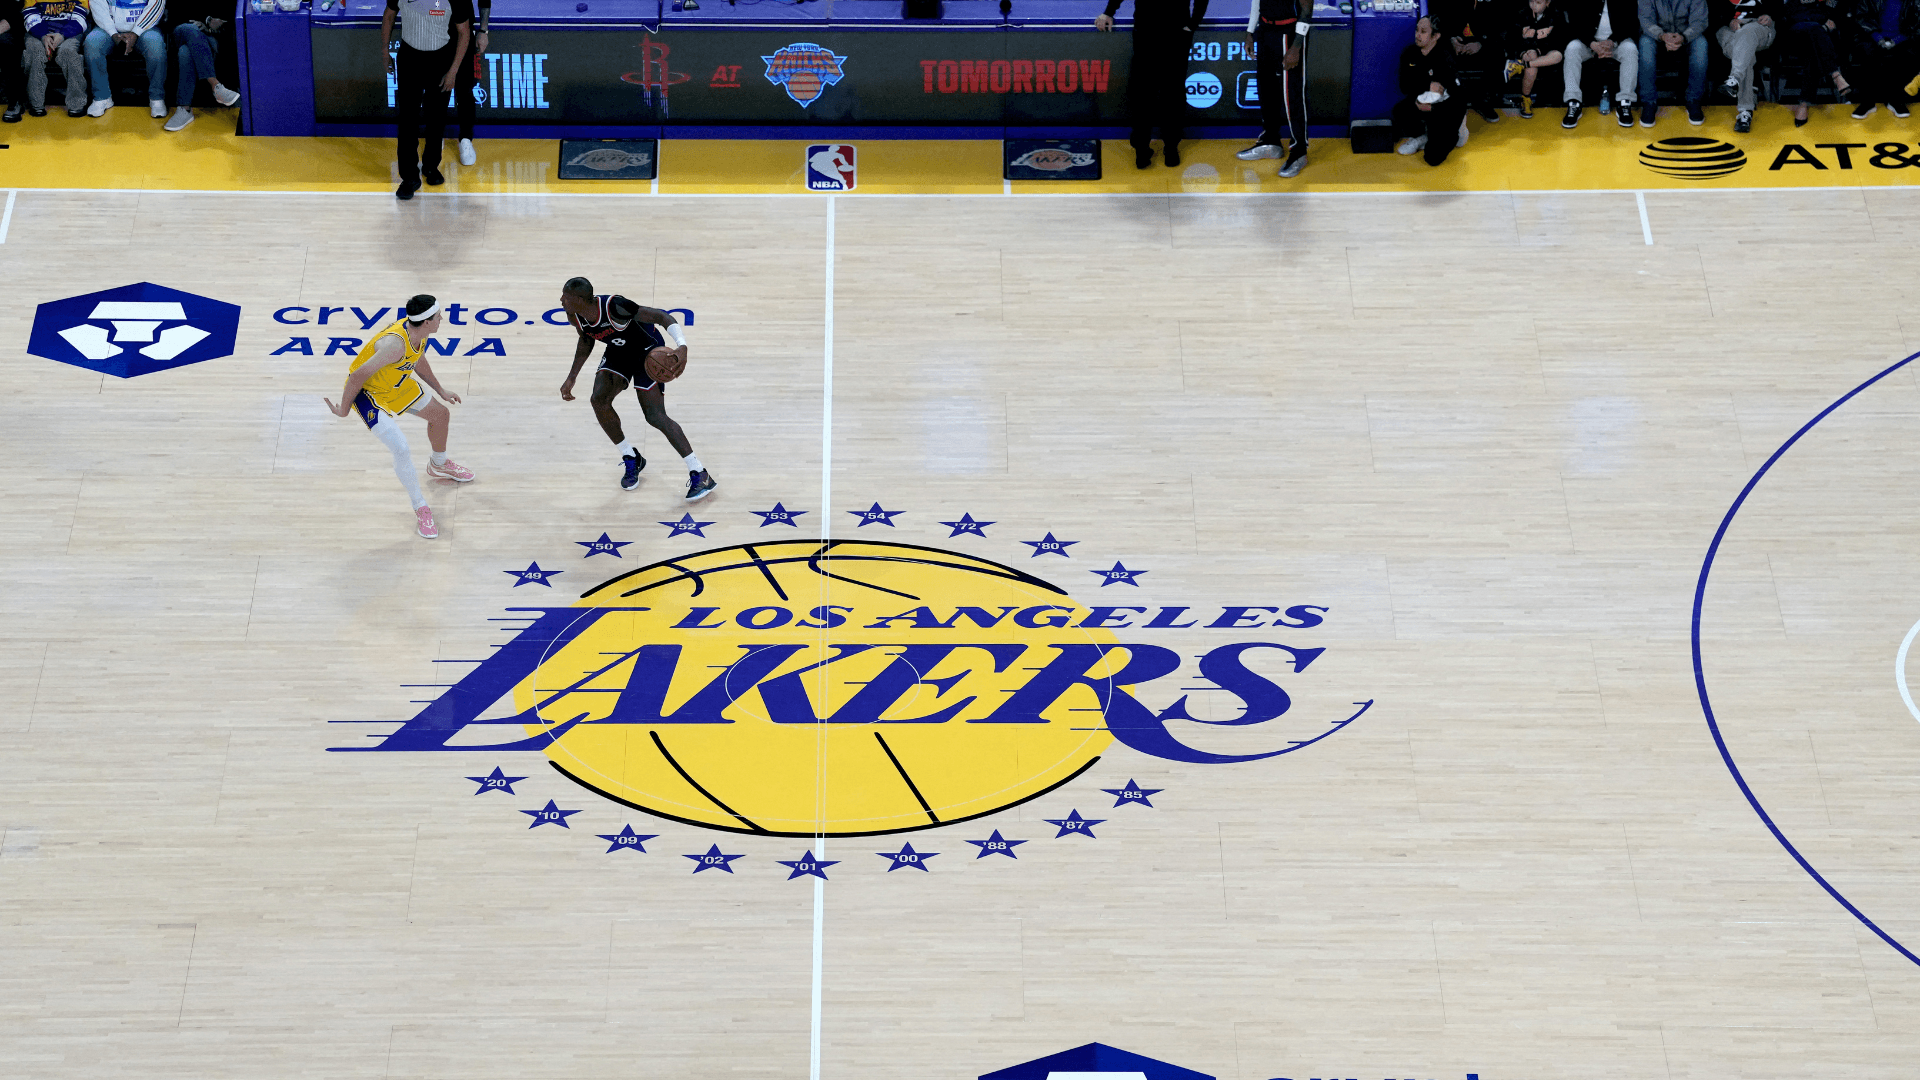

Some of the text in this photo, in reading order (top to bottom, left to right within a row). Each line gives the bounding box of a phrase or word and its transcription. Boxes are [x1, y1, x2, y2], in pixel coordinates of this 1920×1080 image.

[1187, 41, 1222, 61] :30
[767, 51, 841, 77] KNICKS
[711, 65, 743, 82] AT
[920, 60, 1111, 94] TOMORROW
[485, 53, 550, 109] TIME
[1185, 82, 1220, 95] abc
[1768, 142, 1920, 171] AT&
[812, 180, 841, 189] NBA
[272, 303, 695, 330] cryto.c
[268, 336, 508, 357] ARNA
[766, 512, 788, 520] '53
[863, 512, 886, 520] '54
[674, 522, 697, 530] '52
[954, 522, 977, 530] '72
[590, 542, 614, 551] '50
[1037, 542, 1060, 550] '80
[520, 571, 543, 580] '49
[1106, 571, 1129, 579] '82
[669, 604, 1331, 629] LOS ANGELES
[325, 606, 1374, 764] LAKERS
[484, 777, 507, 787] '20
[1118, 790, 1143, 799] '85
[538, 811, 560, 820] '10
[1061, 820, 1085, 830] '87
[613, 836, 638, 845] '09
[982, 841, 1007, 850] '88
[700, 856, 724, 865] '02
[894, 854, 919, 863] '00
[794, 862, 816, 871] '01
